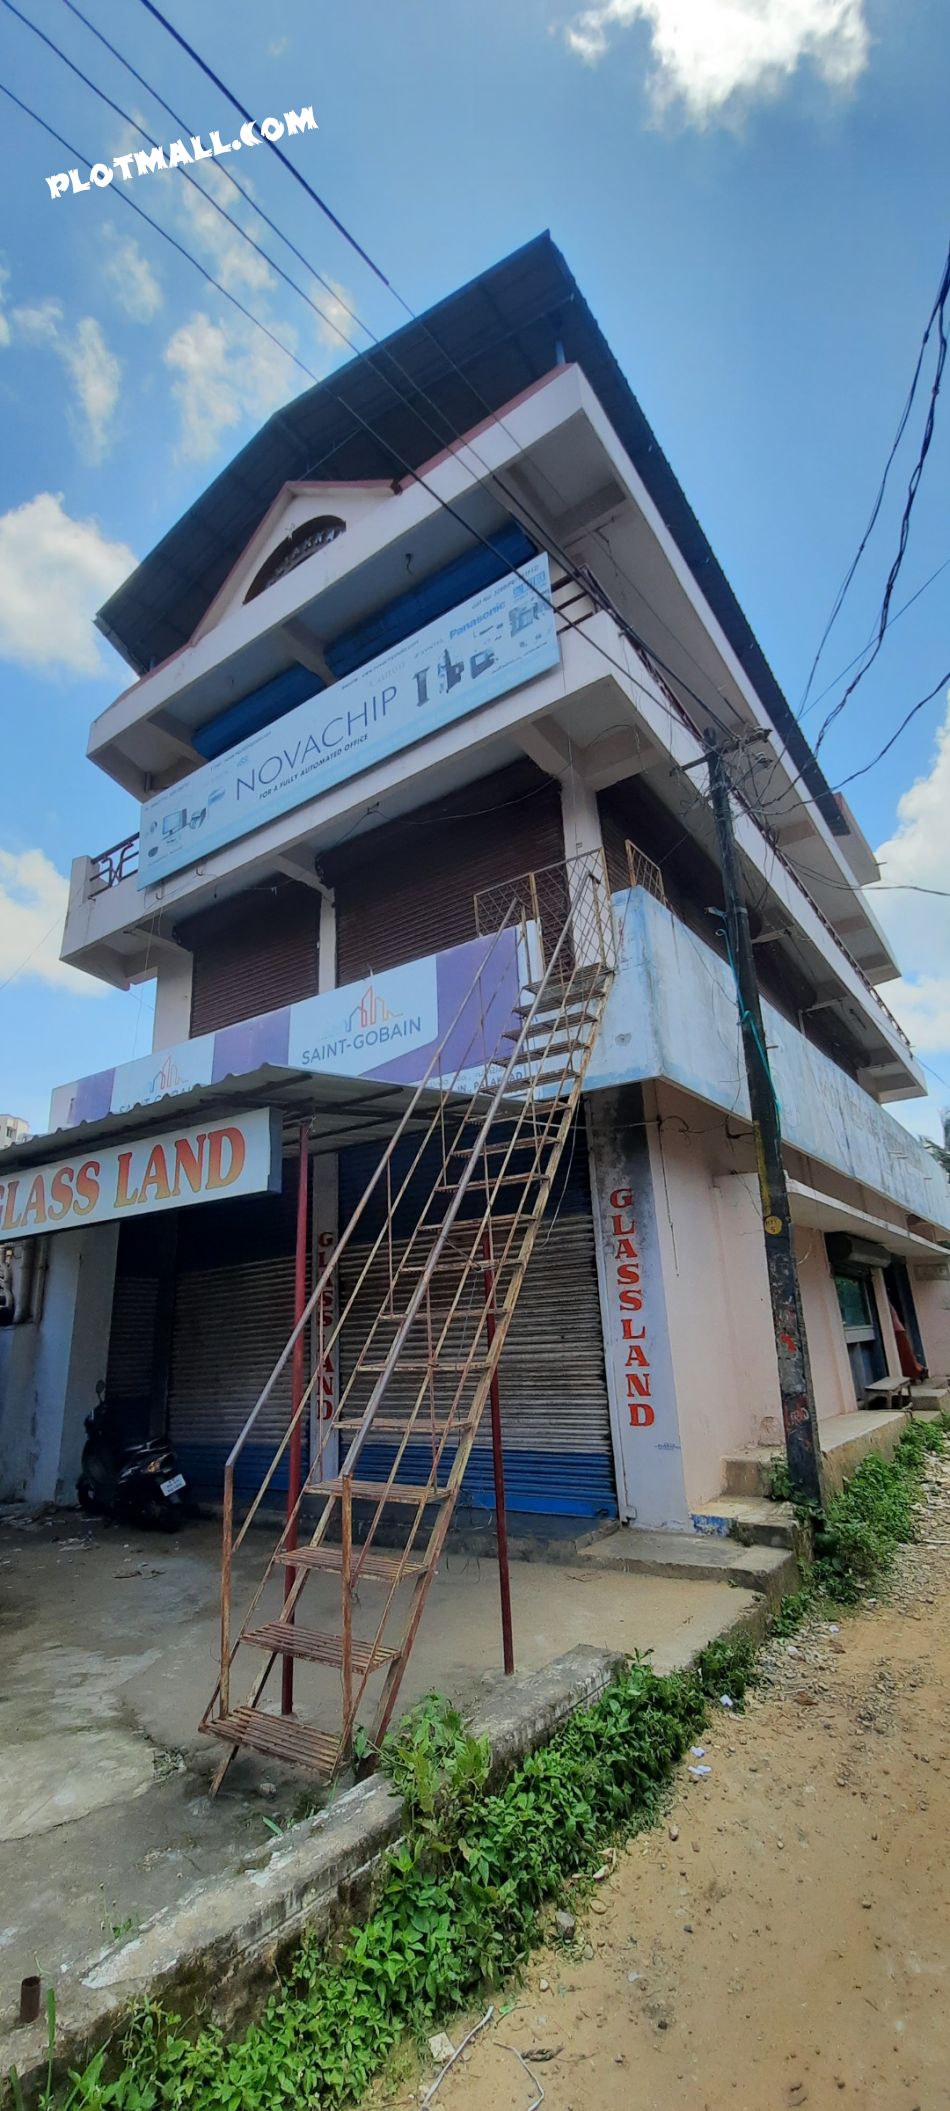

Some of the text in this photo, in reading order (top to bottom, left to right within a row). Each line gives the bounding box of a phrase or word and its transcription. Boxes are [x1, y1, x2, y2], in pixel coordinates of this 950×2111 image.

[448, 600, 508, 641] Panasonic
[236, 686, 397, 800] NOVACHIP
[259, 788, 272, 800] FOR
[280, 775, 298, 788] FULLY
[299, 749, 342, 776] AUTOMATED
[344, 733, 369, 751] OFFICE
[301, 1016, 422, 1066] SAINT-GOBAIN
[0, 1127, 245, 1232] LASS LAND
